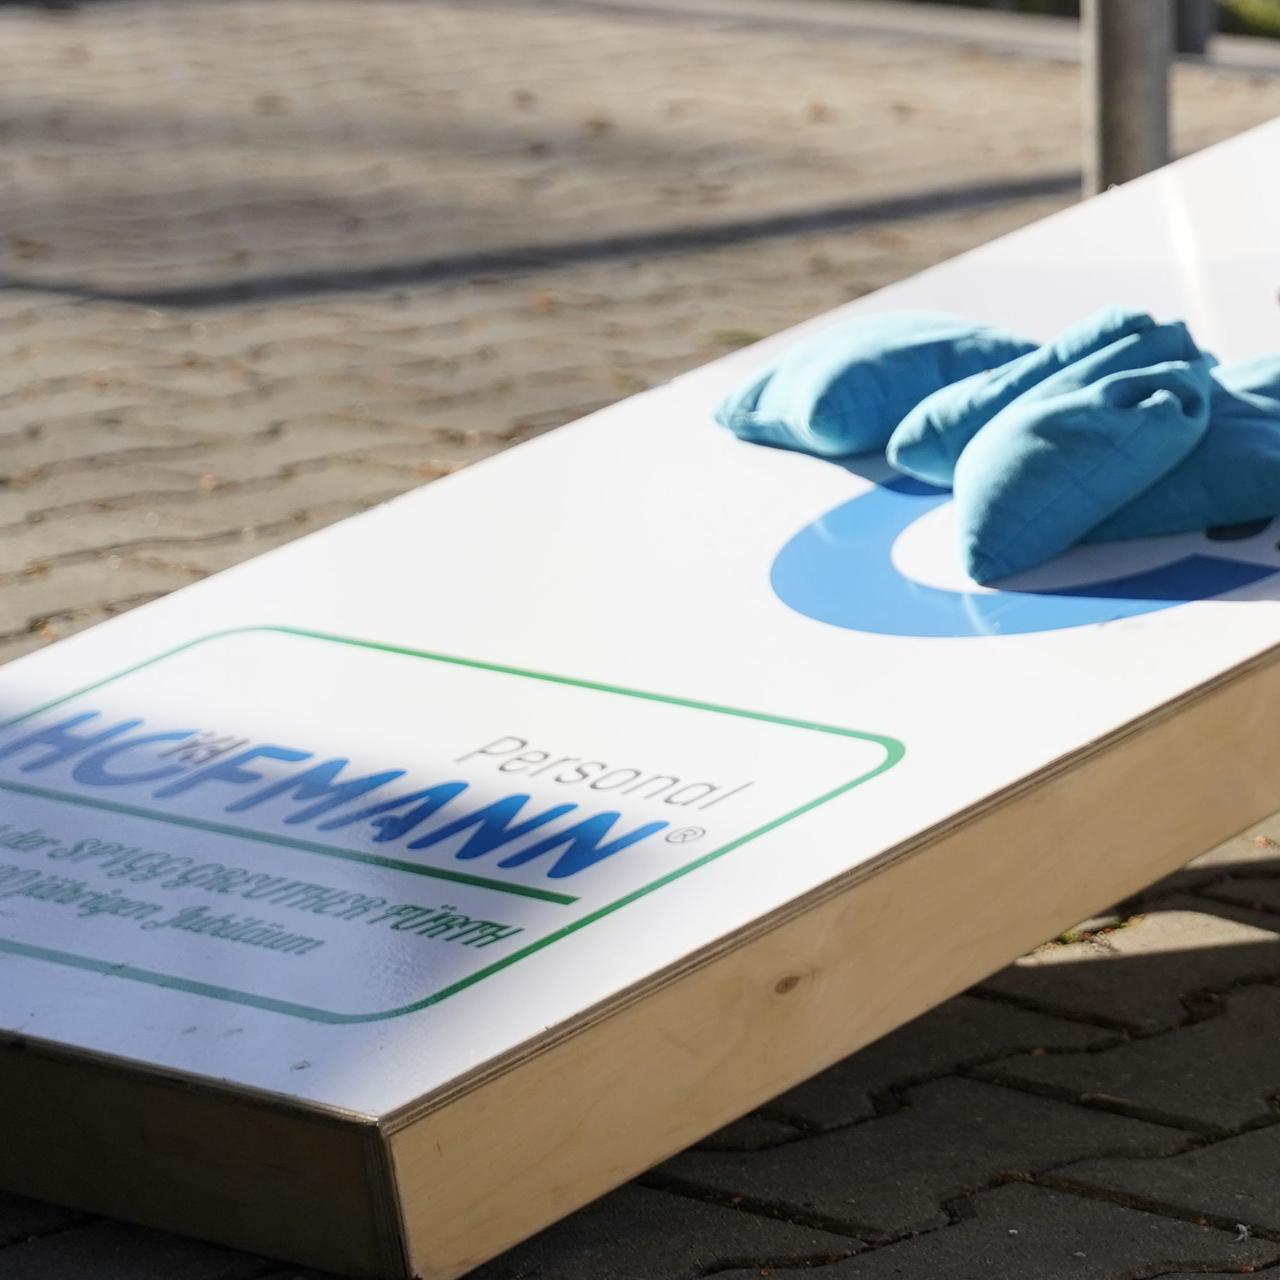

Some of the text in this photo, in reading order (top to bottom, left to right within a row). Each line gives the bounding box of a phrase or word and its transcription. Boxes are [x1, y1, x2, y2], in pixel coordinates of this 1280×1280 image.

[454, 735, 755, 800] Personal
[140, 905, 325, 955] Jubiläum
[366, 904, 524, 948] FÜRTH
